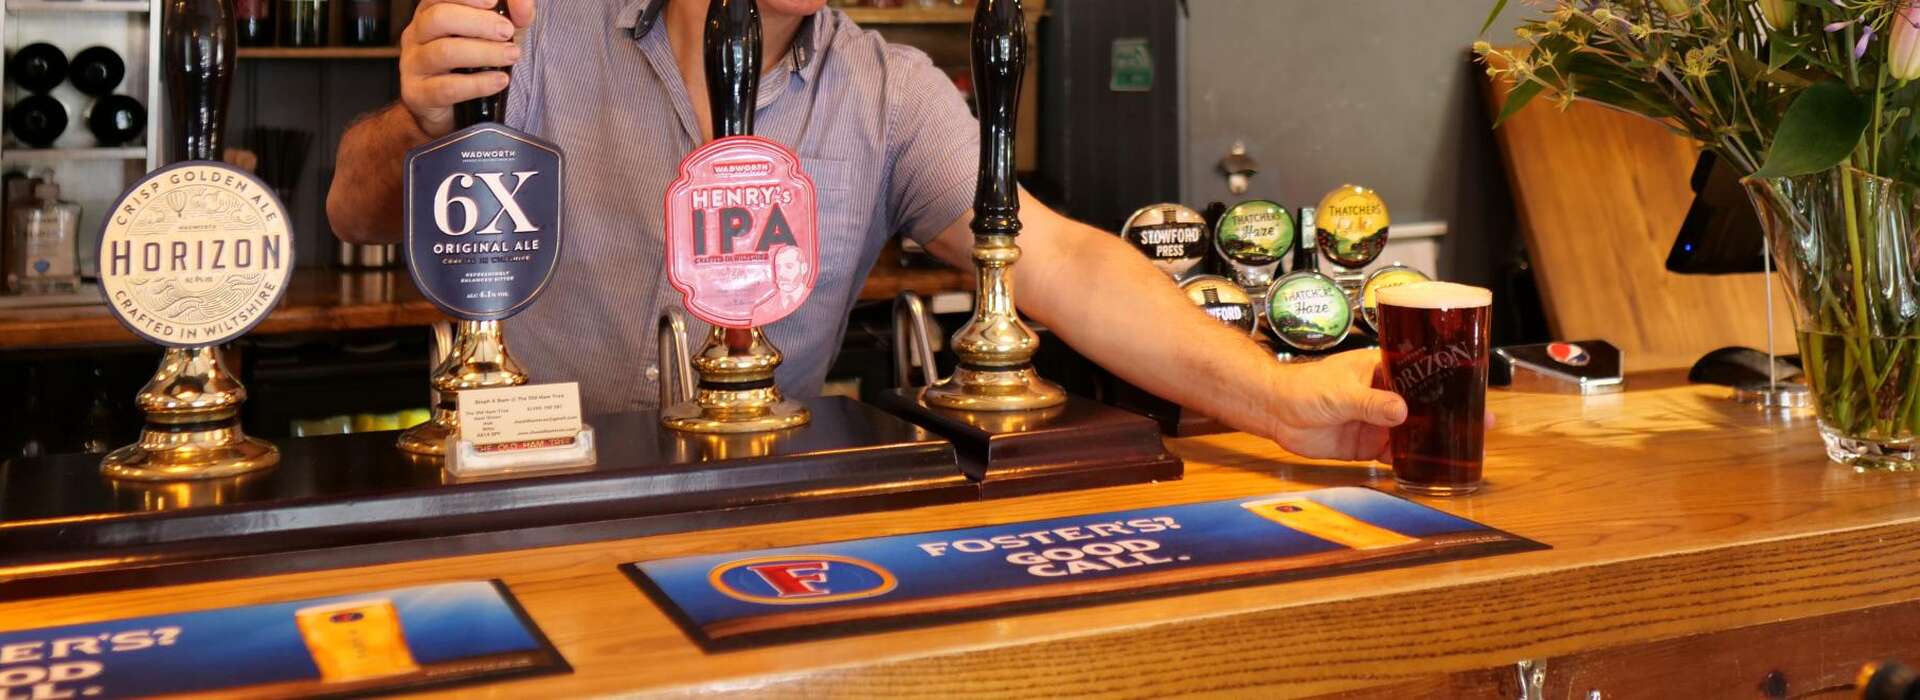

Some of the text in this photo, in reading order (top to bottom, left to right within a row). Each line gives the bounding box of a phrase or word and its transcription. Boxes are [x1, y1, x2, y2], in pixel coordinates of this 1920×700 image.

[461, 150, 516, 158] WADWORTH
[714, 164, 769, 174] WADWORTH
[116, 171, 277, 226] CRISP GOLDEN ALE
[433, 171, 540, 236] 6X
[1328, 204, 1382, 217] THATCHERS
[692, 203, 798, 256] IPA
[1231, 211, 1281, 226] THATCHERS
[1241, 224, 1275, 240] Haze
[433, 239, 540, 254] ORIGINAL ALE
[1141, 226, 1199, 245] STOWFORD
[110, 234, 281, 276] HORIZON
[1156, 244, 1185, 257] PRESS
[115, 283, 276, 339] CRAFTED IN WILTSHIRE
[1295, 302, 1329, 315] Haze
[1390, 340, 1474, 395] ORIZON
[522, 440, 544, 449] HAM
[917, 516, 1183, 558] FOSTER'S?
[1005, 538, 1161, 567] GOOD
[1027, 550, 1192, 578] CALL.
[747, 561, 831, 599] F
[0, 626, 182, 665] ER'S?
[0, 660, 104, 687] OD
